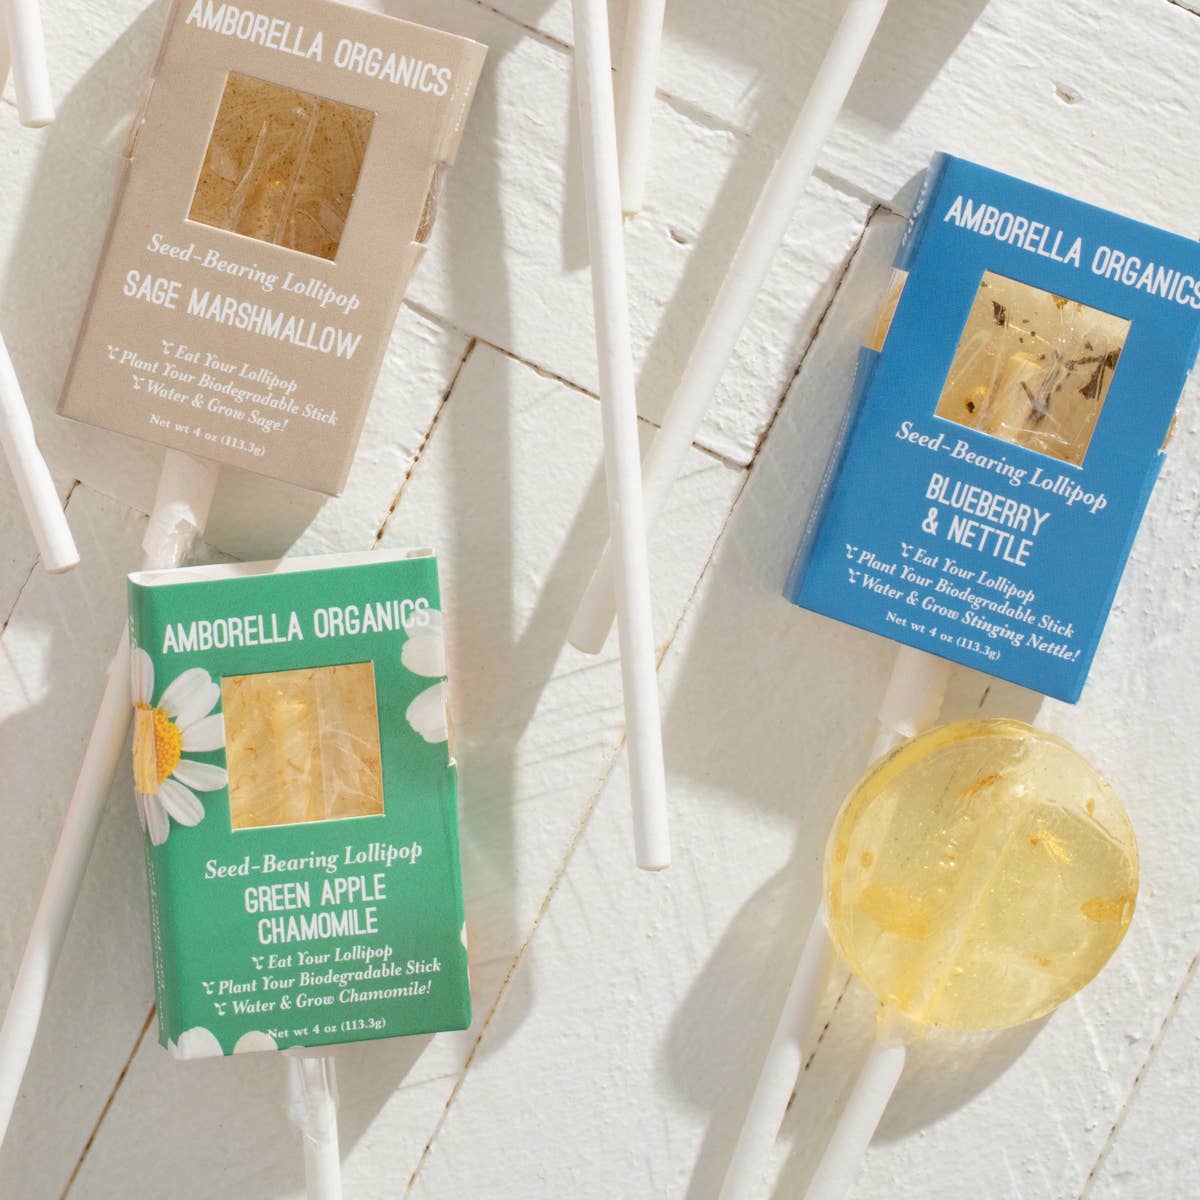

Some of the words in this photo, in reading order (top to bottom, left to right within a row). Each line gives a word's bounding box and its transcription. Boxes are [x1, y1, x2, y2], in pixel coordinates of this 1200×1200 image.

[333, 38, 452, 97] ORGANICS
[943, 195, 1083, 268] AMBORELLA
[146, 233, 280, 293] Seed-Bearing
[280, 271, 361, 316] Lollipop
[122, 269, 183, 310] SAGE
[187, 287, 363, 360] MARSHMALLOW
[119, 350, 160, 374] Plant
[162, 362, 196, 383] Your
[196, 372, 300, 415] Biodegradable
[300, 403, 338, 427] Stick
[146, 378, 189, 403] Water
[191, 392, 205, 409] &
[207, 397, 246, 421] Grow
[247, 409, 289, 433] Sage!
[895, 420, 1028, 487] Seed-Bearing
[1028, 467, 1108, 515] Lollipop
[925, 472, 1051, 537] BLUEBERRY
[921, 506, 939, 536] &
[946, 514, 1034, 567] NETTLE
[162, 611, 304, 655] AMBORELLA
[313, 597, 430, 639] ORGANICS
[862, 573, 905, 600] Water
[905, 590, 919, 606] &
[921, 596, 960, 620] Grow
[960, 610, 1025, 647] Stinging
[1025, 633, 1081, 663] Nettle!
[885, 610, 908, 627] Net
[910, 622, 926, 634] wt
[928, 627, 938, 637] 4
[939, 633, 954, 643] oz
[956, 636, 1001, 661] (113.3g)
[204, 850, 340, 880] Seed-Bearing
[343, 841, 423, 868] Lollipop
[244, 881, 311, 914] GREEN
[320, 872, 387, 906] APPLE
[257, 906, 379, 945] CHAMOMILE
[217, 979, 258, 996] Plant
[261, 975, 296, 991] Your
[299, 962, 402, 987] Biodegradable
[405, 957, 442, 975] Stick
[232, 999, 277, 1015] Water
[279, 994, 292, 1011] &
[295, 992, 335, 1009] Grow
[338, 980, 432, 1004] Chamomile!
